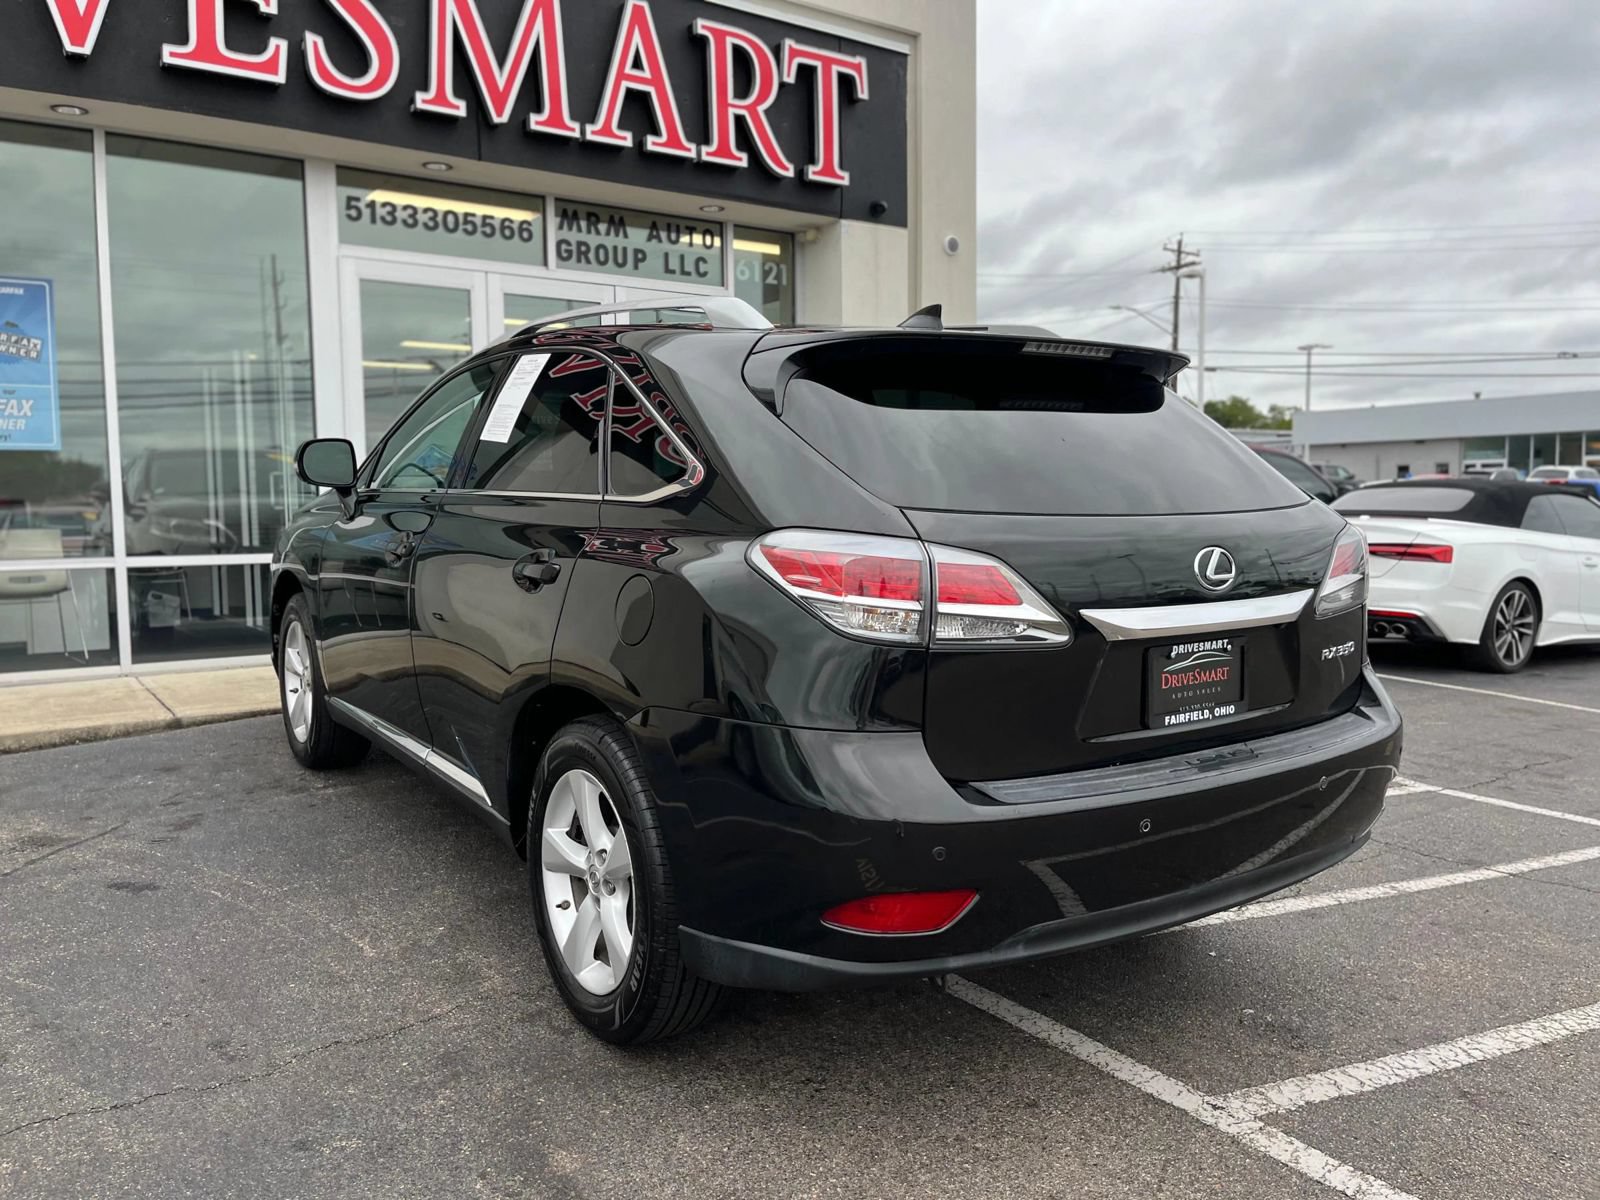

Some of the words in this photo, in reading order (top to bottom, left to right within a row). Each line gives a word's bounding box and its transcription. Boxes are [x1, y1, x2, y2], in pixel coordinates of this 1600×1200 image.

[344, 195, 534, 243] 5133305566
[557, 207, 630, 239] MRM
[646, 220, 715, 251] AUTO
[555, 239, 647, 271] GROUP
[663, 252, 709, 279] LLC
[736, 261, 788, 286] 6121
[1164, 709, 1213, 726] FAIRFIELD,
[1214, 705, 1235, 717] OHIO
